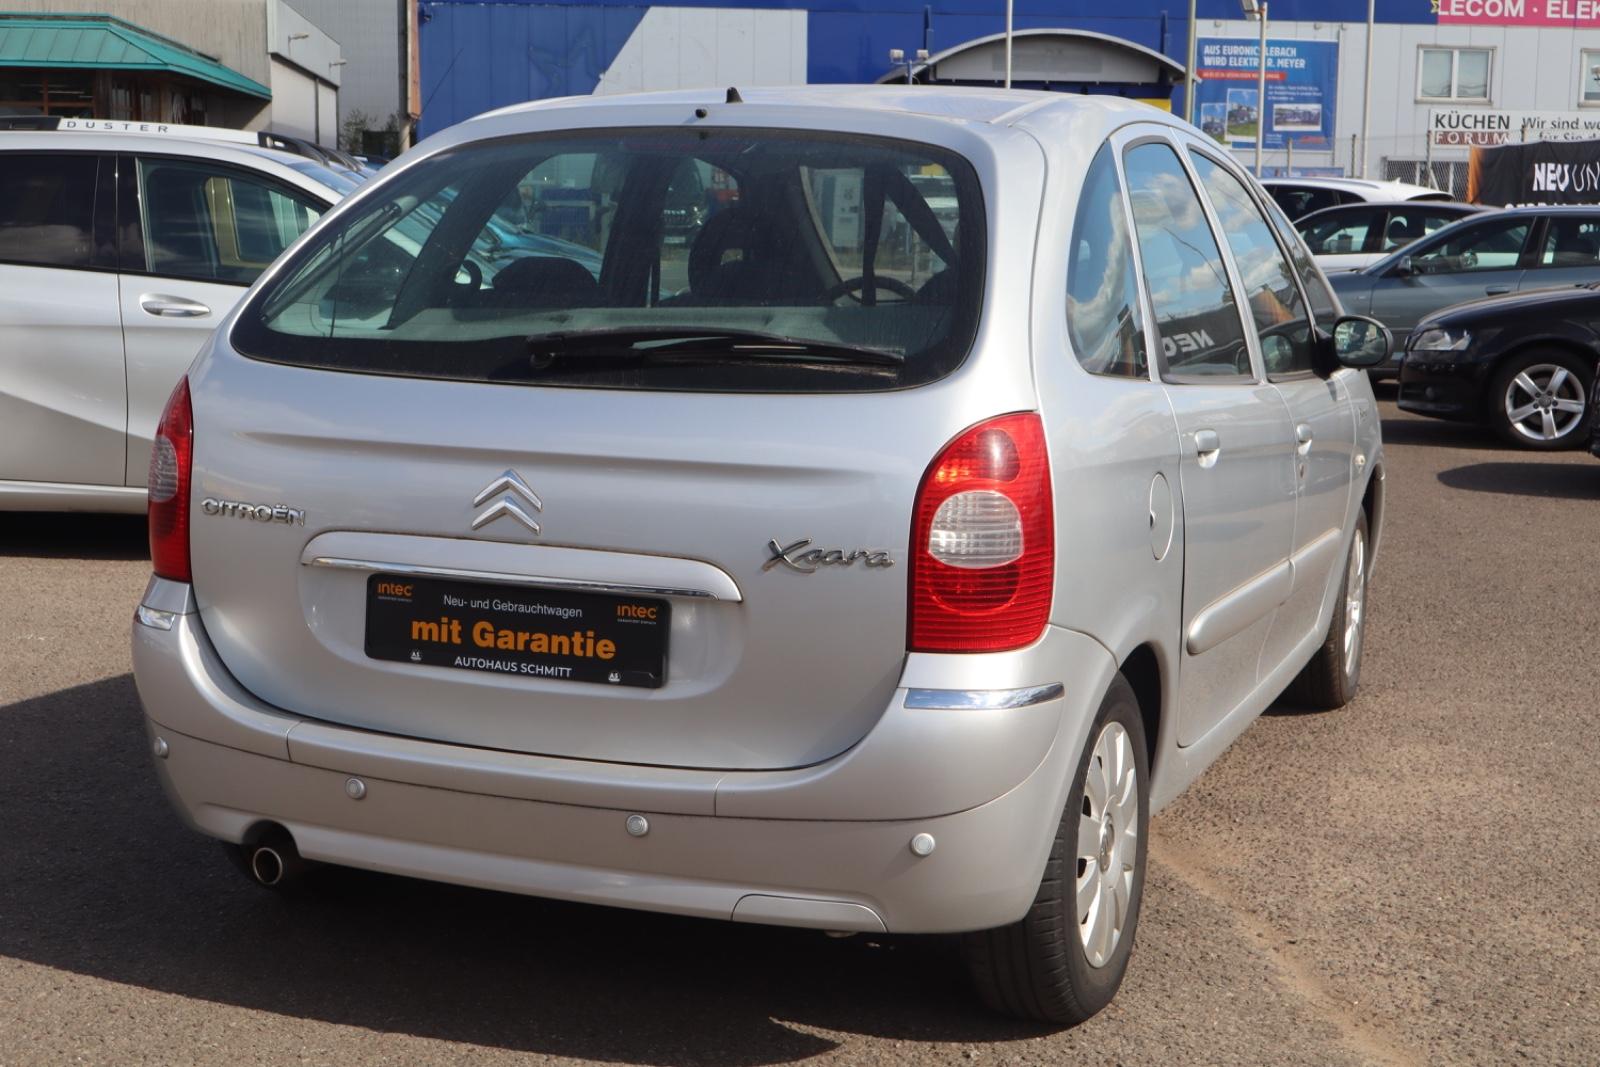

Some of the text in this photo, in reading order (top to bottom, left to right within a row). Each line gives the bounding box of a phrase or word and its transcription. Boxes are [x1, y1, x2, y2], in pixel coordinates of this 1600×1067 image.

[1203, 45, 1220, 55] AUS
[1222, 46, 1261, 57] EURONIC
[1203, 56, 1227, 66] WIRD
[1229, 57, 1261, 67] ELEKTR
[1277, 58, 1306, 69] MEYER
[66, 121, 169, 133] DUSTER
[1434, 111, 1510, 130] KÜCHEN
[1521, 117, 1546, 130] Wir
[1550, 117, 1579, 130] sind
[1435, 131, 1509, 144] FORUM
[1532, 163, 1570, 192] NEU
[200, 497, 305, 527] CITROËN
[762, 536, 896, 574] Xsara
[378, 583, 413, 597] intec
[443, 594, 583, 619] Neu- und Gebrauchtwagen
[617, 604, 656, 619] intec
[411, 616, 616, 660] mit Garantie
[454, 656, 572, 678] AUTOHAUS SCHMITT
